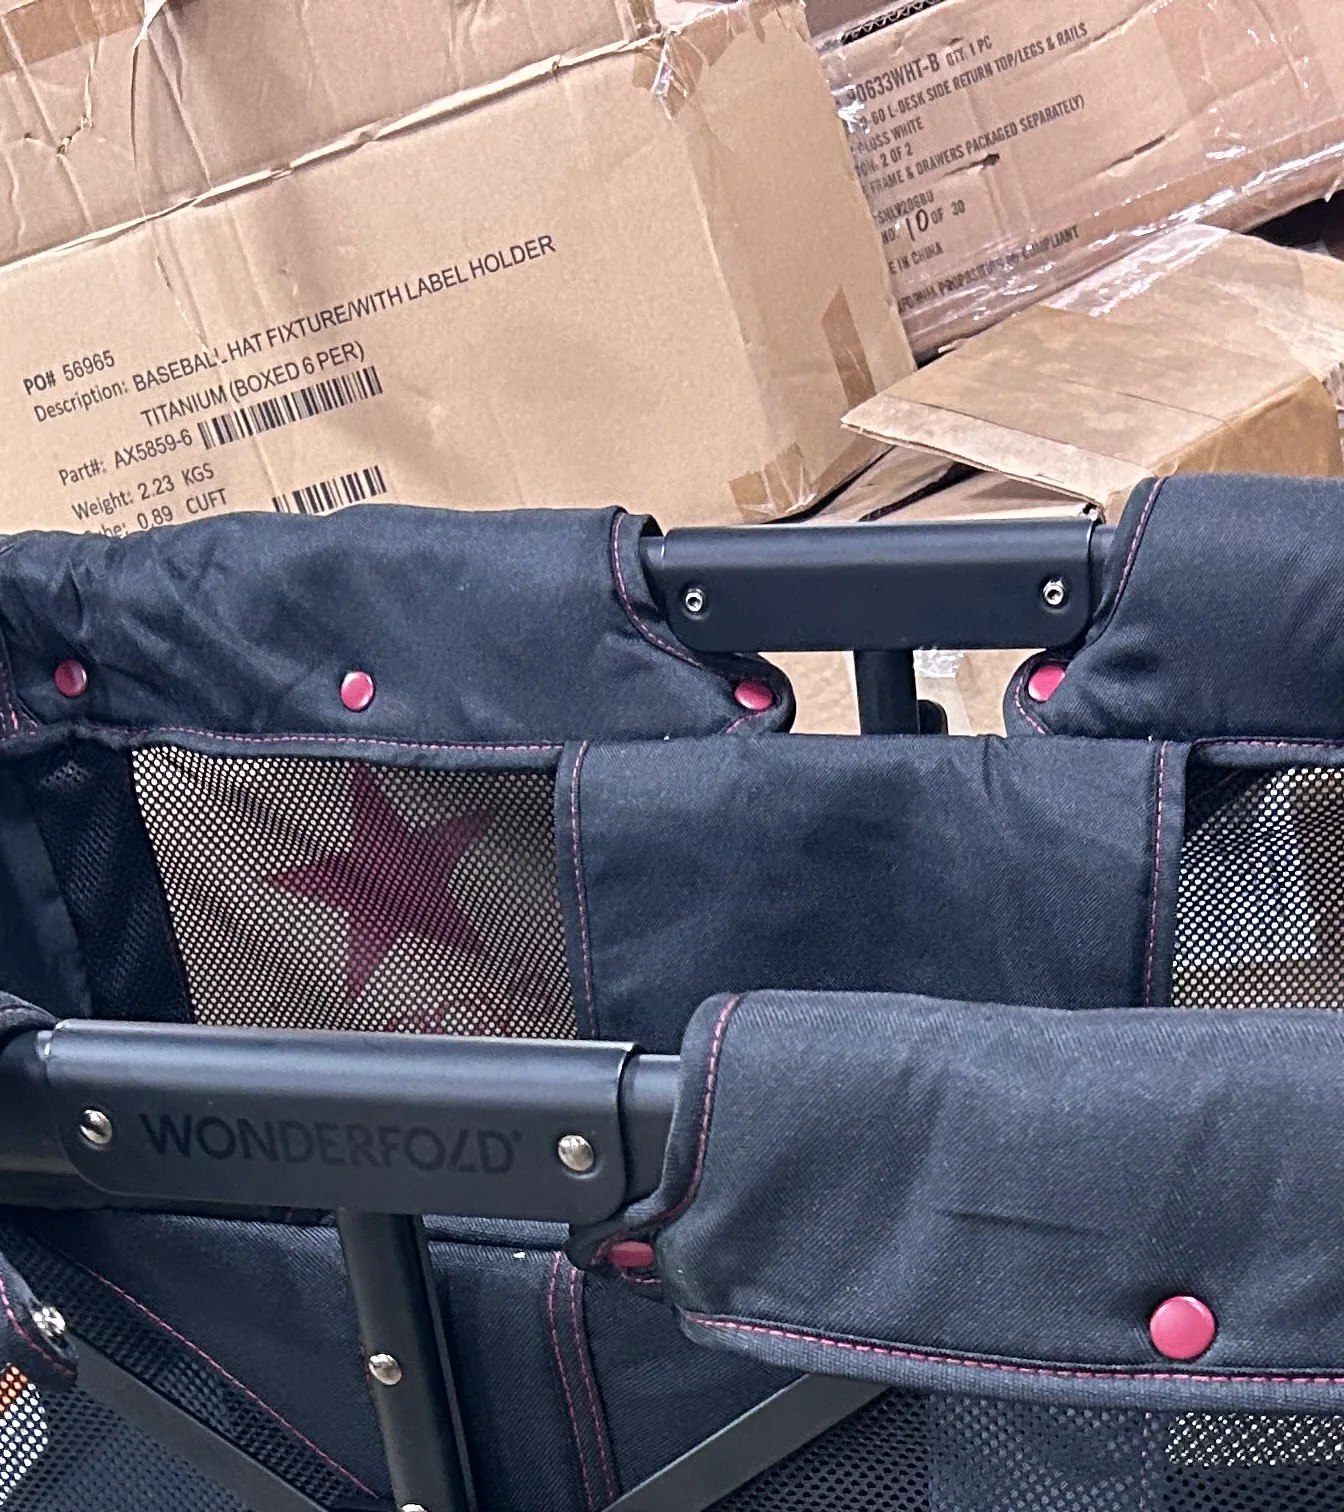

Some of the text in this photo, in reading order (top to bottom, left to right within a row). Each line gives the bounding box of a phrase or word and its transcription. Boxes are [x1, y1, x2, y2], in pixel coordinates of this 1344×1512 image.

[977, 35, 993, 53] PC
[887, 92, 926, 119] L-DESK
[926, 81, 952, 102] SIDE
[952, 62, 993, 90] RETURN
[993, 41, 1045, 73] TOP/LEGS
[1046, 36, 1055, 51] &
[1056, 22, 1088, 46] RAILS
[869, 94, 1085, 192] FRAME & DRAWERS PACKAGED SEPARATELY)
[890, 116, 924, 140] WHITE
[880, 153, 889, 168] 2
[890, 146, 902, 163] OF
[904, 142, 914, 156] 2
[905, 209, 929, 241] 10
[930, 207, 943, 224] OF
[951, 200, 965, 216] 30
[897, 256, 910, 272] IN
[911, 242, 944, 264] CHINA
[34, 234, 557, 422] Description: BASEBALL HAT FIXTURE/WITH LABEL HOLDER
[23, 350, 115, 395] PO# 56965
[140, 340, 366, 427] TITANIUM (BOXED 6 PER)
[58, 428, 193, 486] Part#: AX5859-6
[71, 462, 215, 521] Weight: 2.23 KGS
[137, 505, 174, 530] 0.89
[185, 488, 227, 515] CUFT
[138, 1113, 518, 1174] WONDERFOLD
